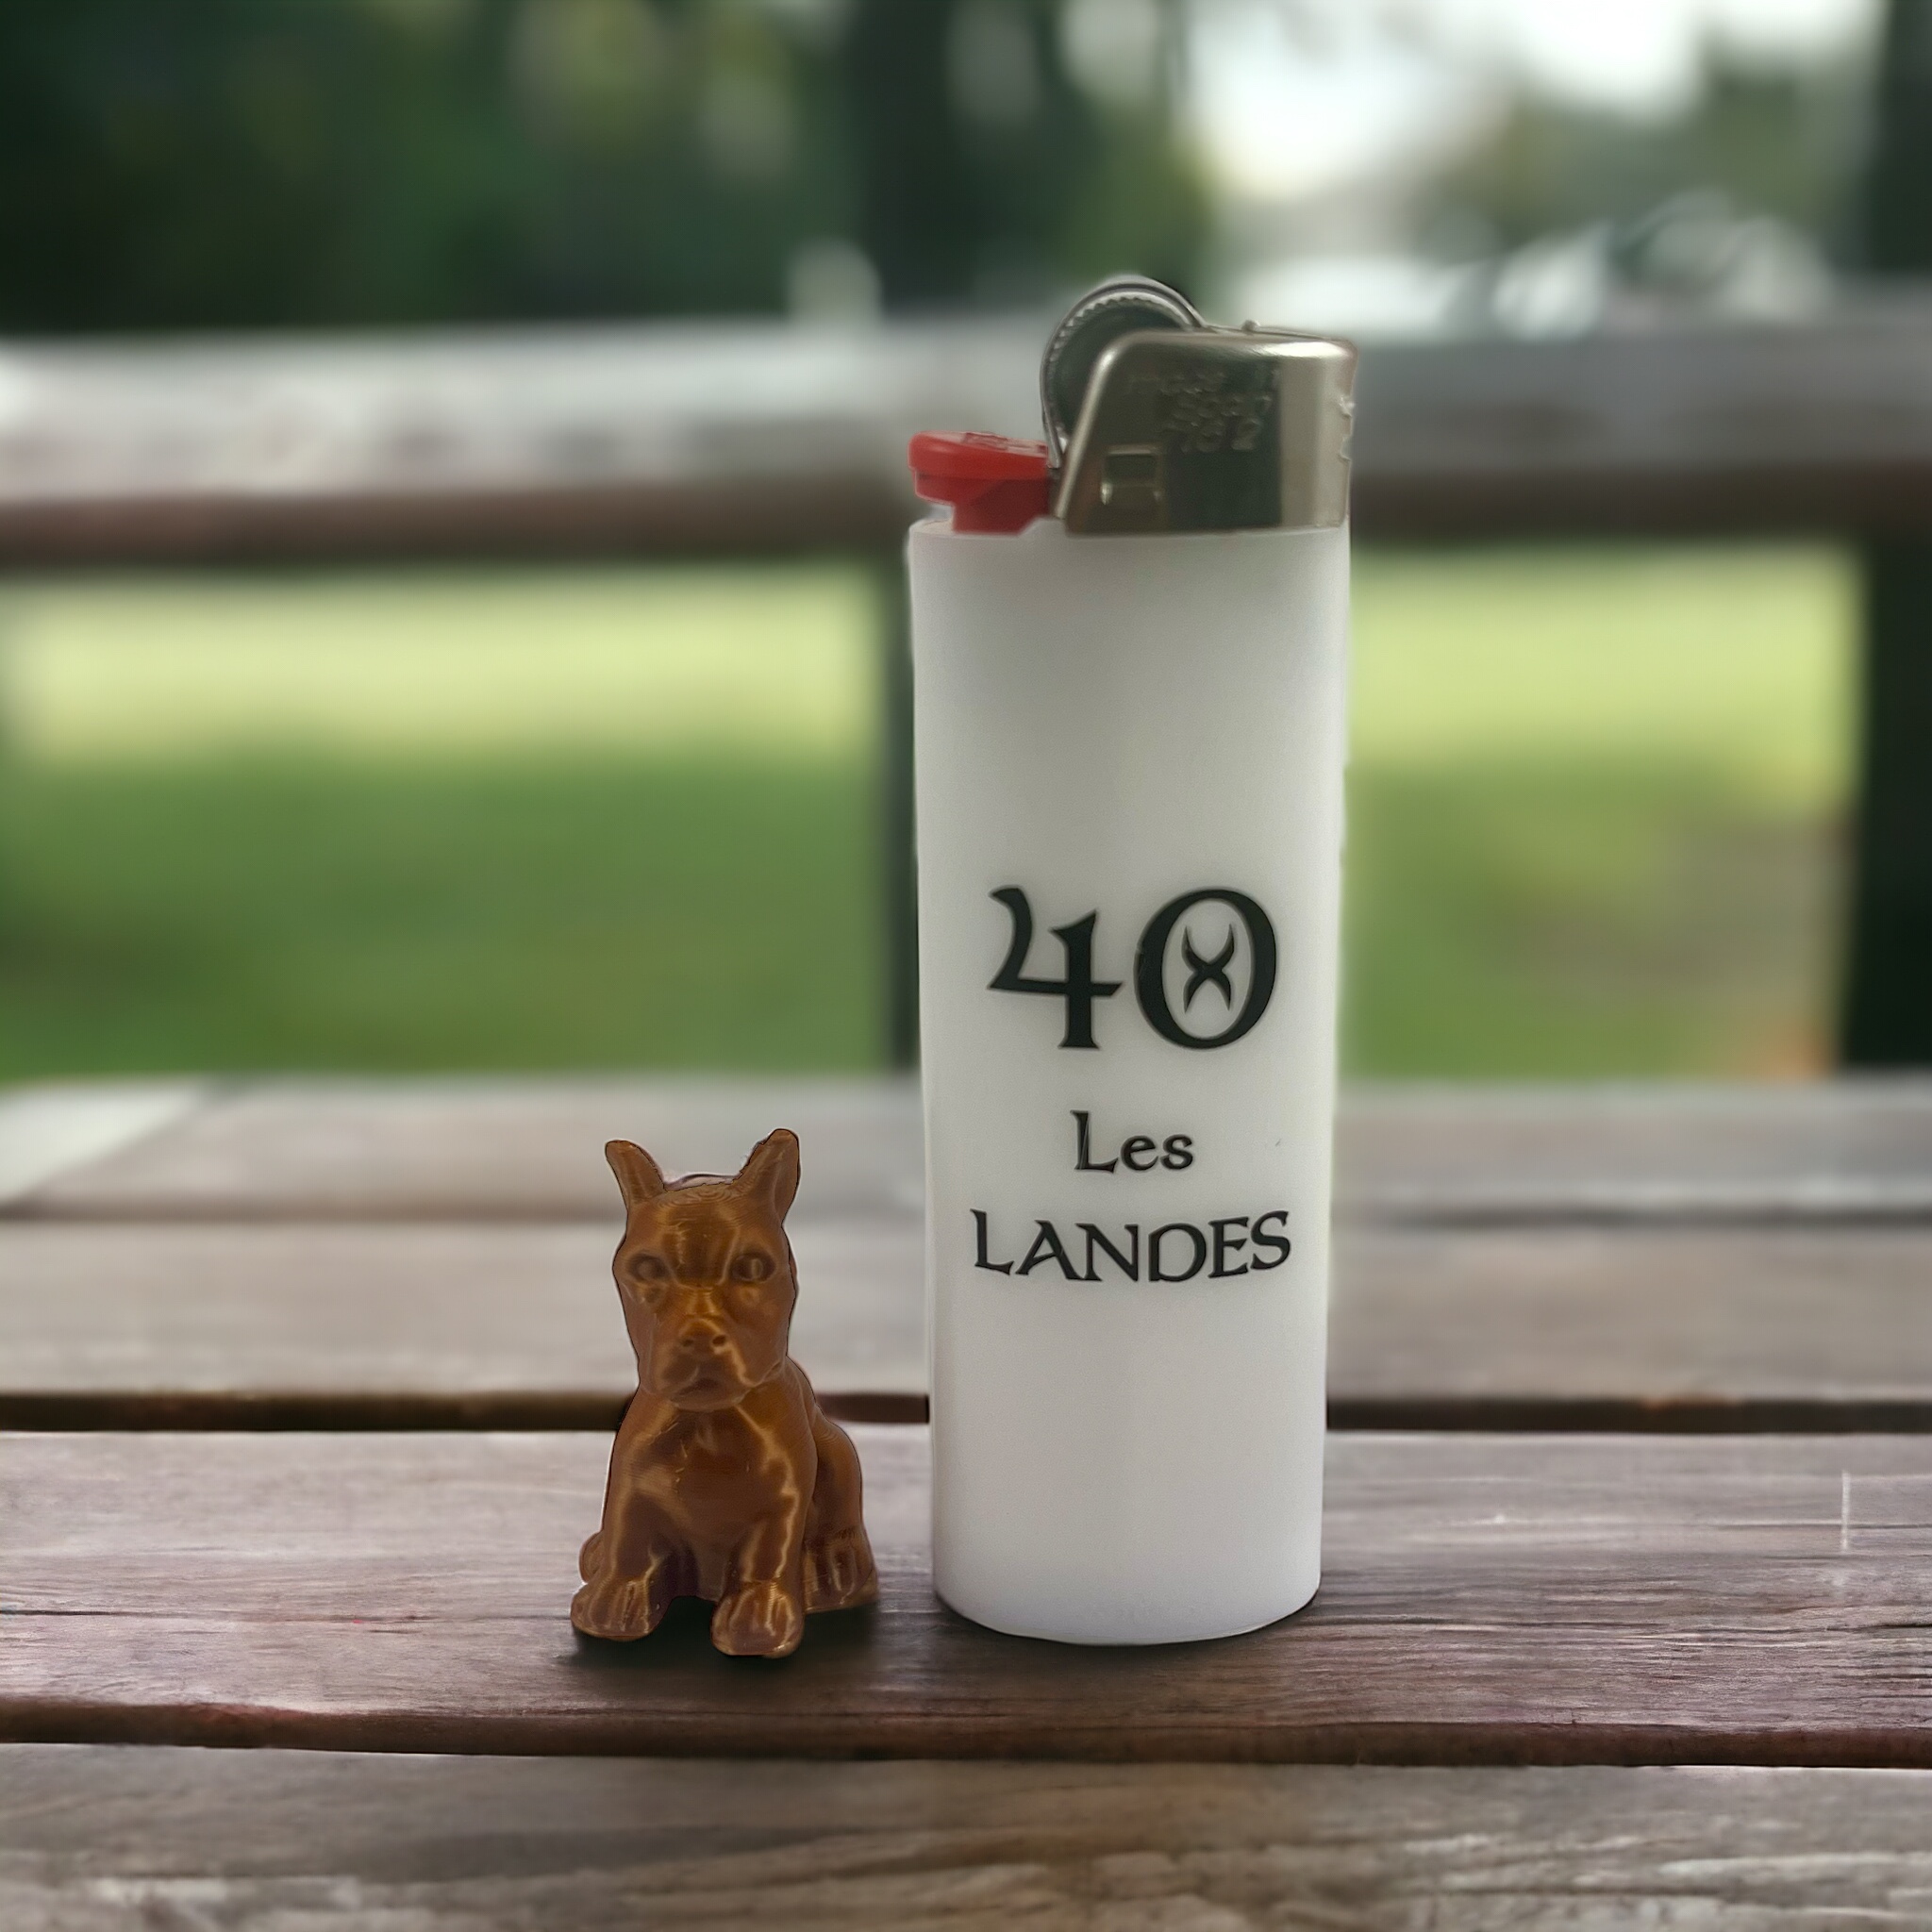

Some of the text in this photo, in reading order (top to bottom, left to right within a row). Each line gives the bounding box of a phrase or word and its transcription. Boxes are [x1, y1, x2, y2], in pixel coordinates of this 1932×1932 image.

[988, 886, 1277, 1050] 40
[1071, 1111, 1194, 1173] Les
[971, 1209, 1291, 1283] LANDES
